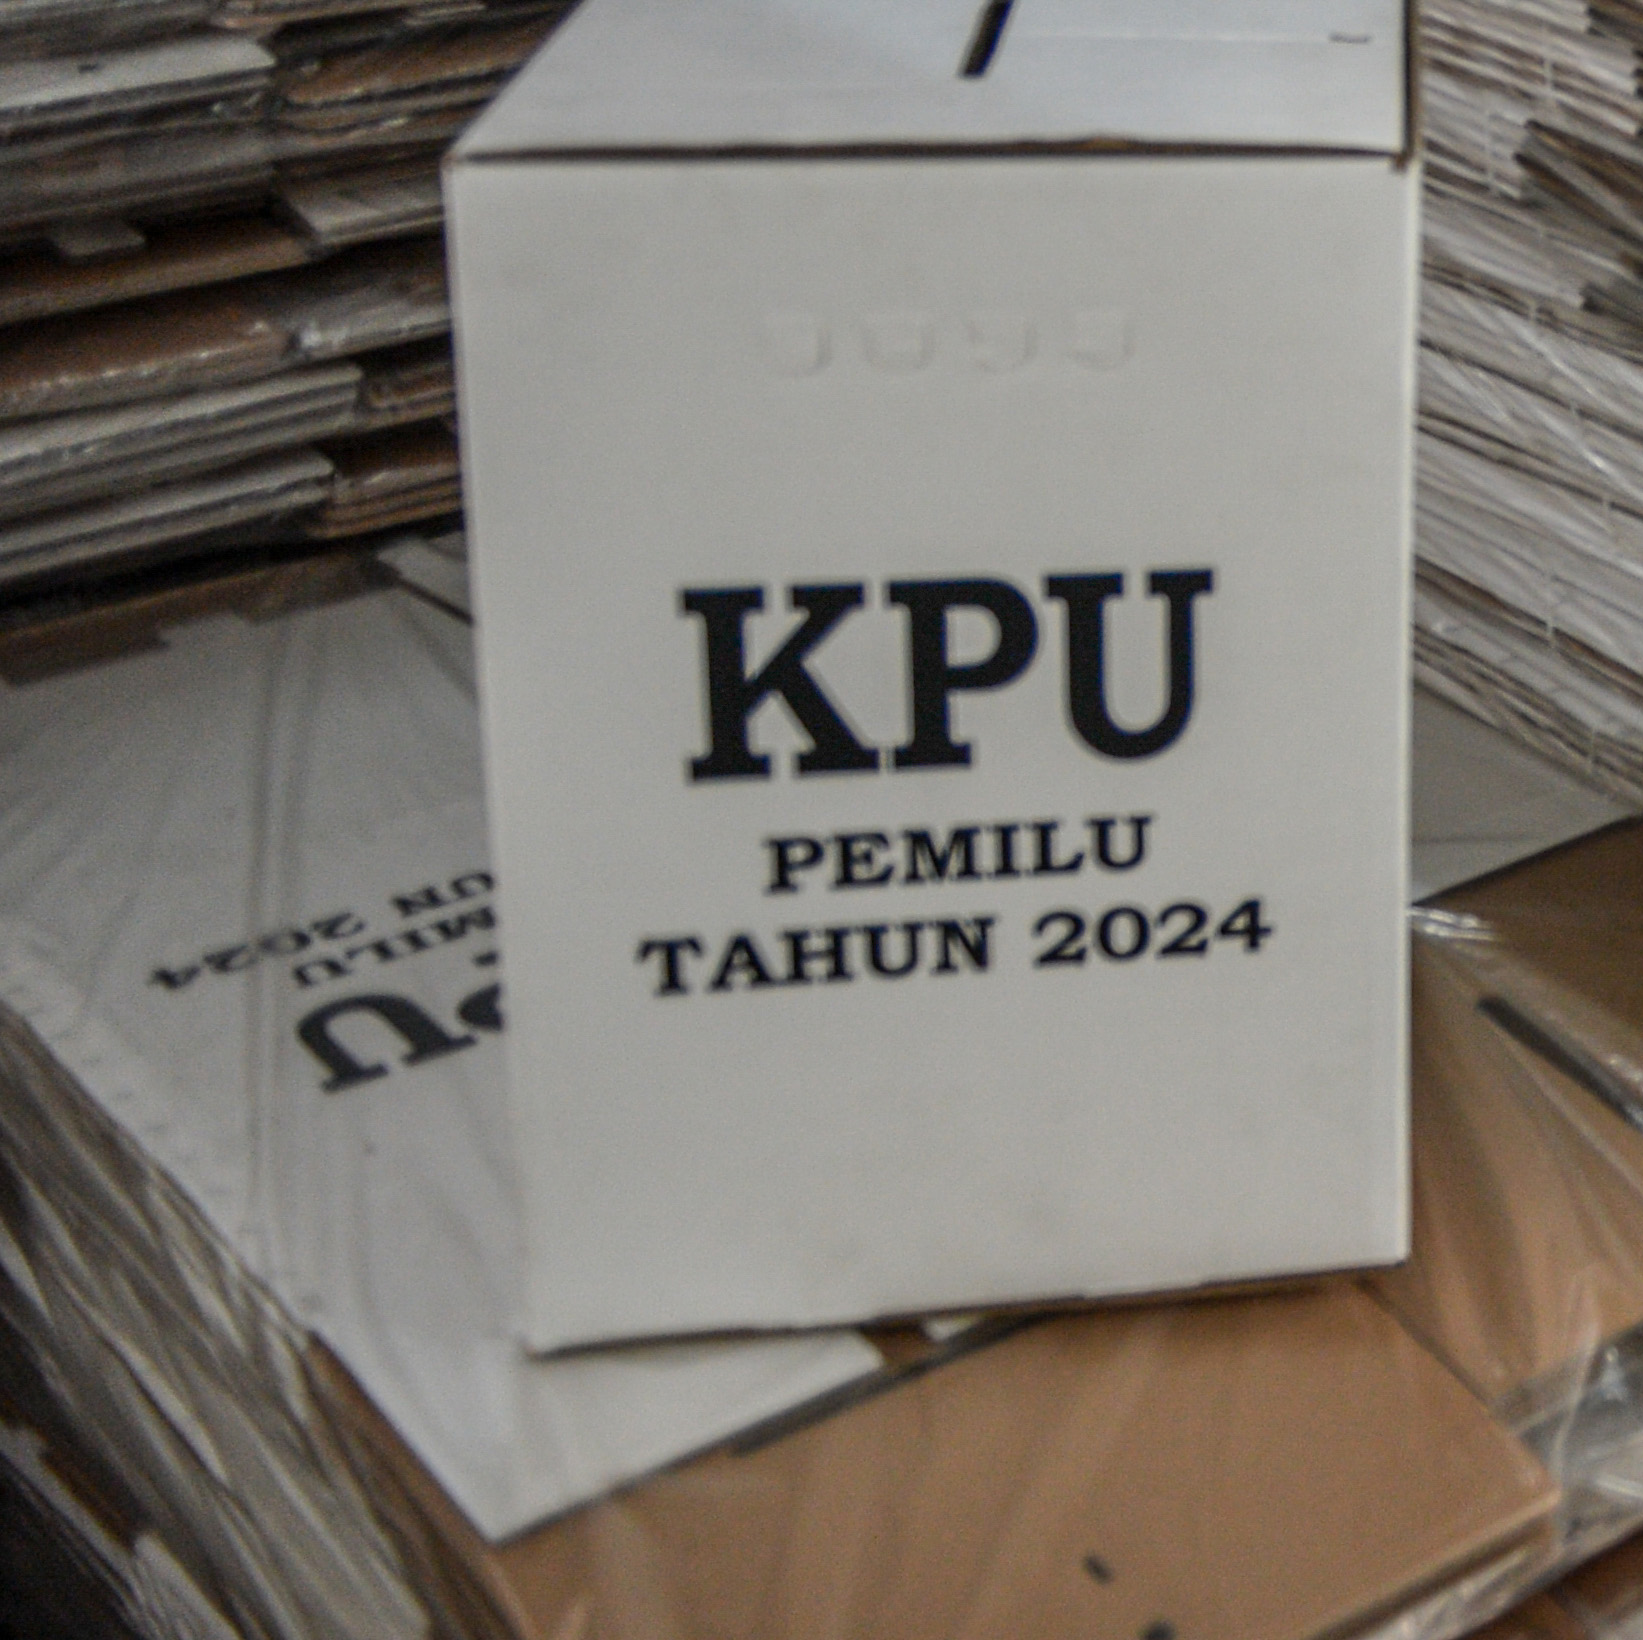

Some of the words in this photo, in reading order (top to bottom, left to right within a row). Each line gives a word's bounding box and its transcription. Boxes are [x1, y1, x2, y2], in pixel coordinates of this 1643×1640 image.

[680, 567, 1216, 784] KPU
[765, 815, 1153, 895] PEMILU
[147, 911, 367, 993] 2024
[637, 914, 996, 997] TAHUN
[1033, 898, 1274, 968] 2024
